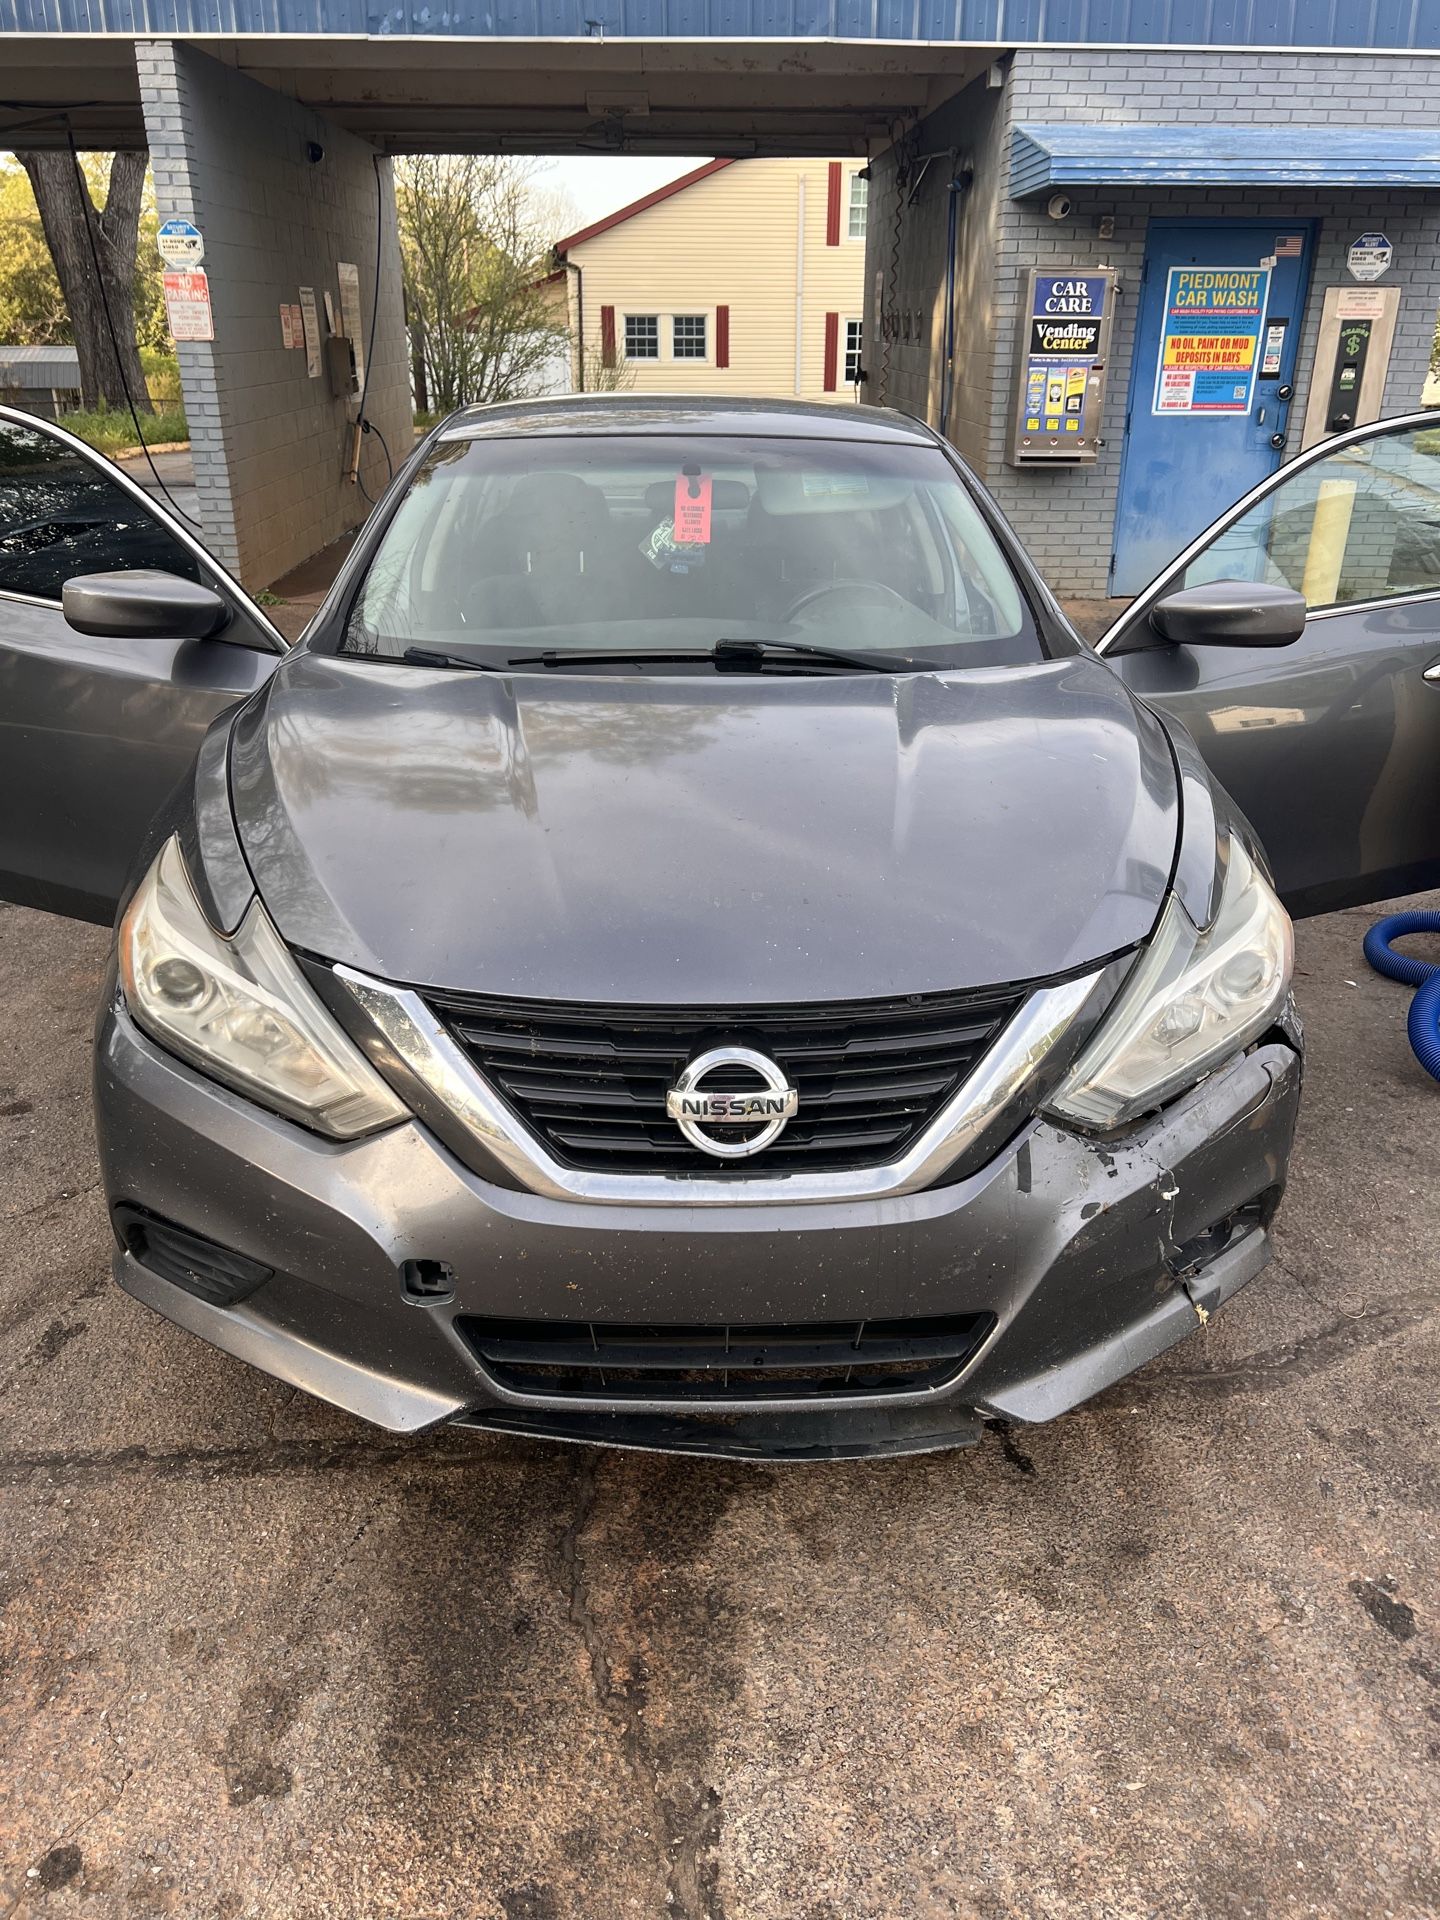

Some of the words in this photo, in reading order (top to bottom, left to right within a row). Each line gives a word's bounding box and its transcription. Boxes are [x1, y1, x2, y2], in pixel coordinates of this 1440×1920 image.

[178, 276, 192, 289] NO
[1052, 281, 1088, 296] CAR
[1179, 273, 1261, 289] PIEDMONT
[166, 288, 208, 301] PARKING
[1175, 290, 1207, 306] CAR
[1212, 290, 1259, 306] WASH
[1045, 297, 1092, 313] CARE
[1037, 324, 1096, 342] Vending
[1043, 336, 1089, 349] Center
[1170, 338, 1182, 349] NO
[1182, 338, 1196, 350] OIL,
[1197, 338, 1220, 349] PAINT
[1220, 338, 1231, 349] OR
[1231, 338, 1249, 349] MUD
[1345, 334, 1361, 356] $
[1175, 351, 1211, 363] DEPOSITS
[1212, 352, 1221, 363] IN
[1221, 351, 1241, 363] BAYS
[682, 1097, 784, 1116] NISSAN
